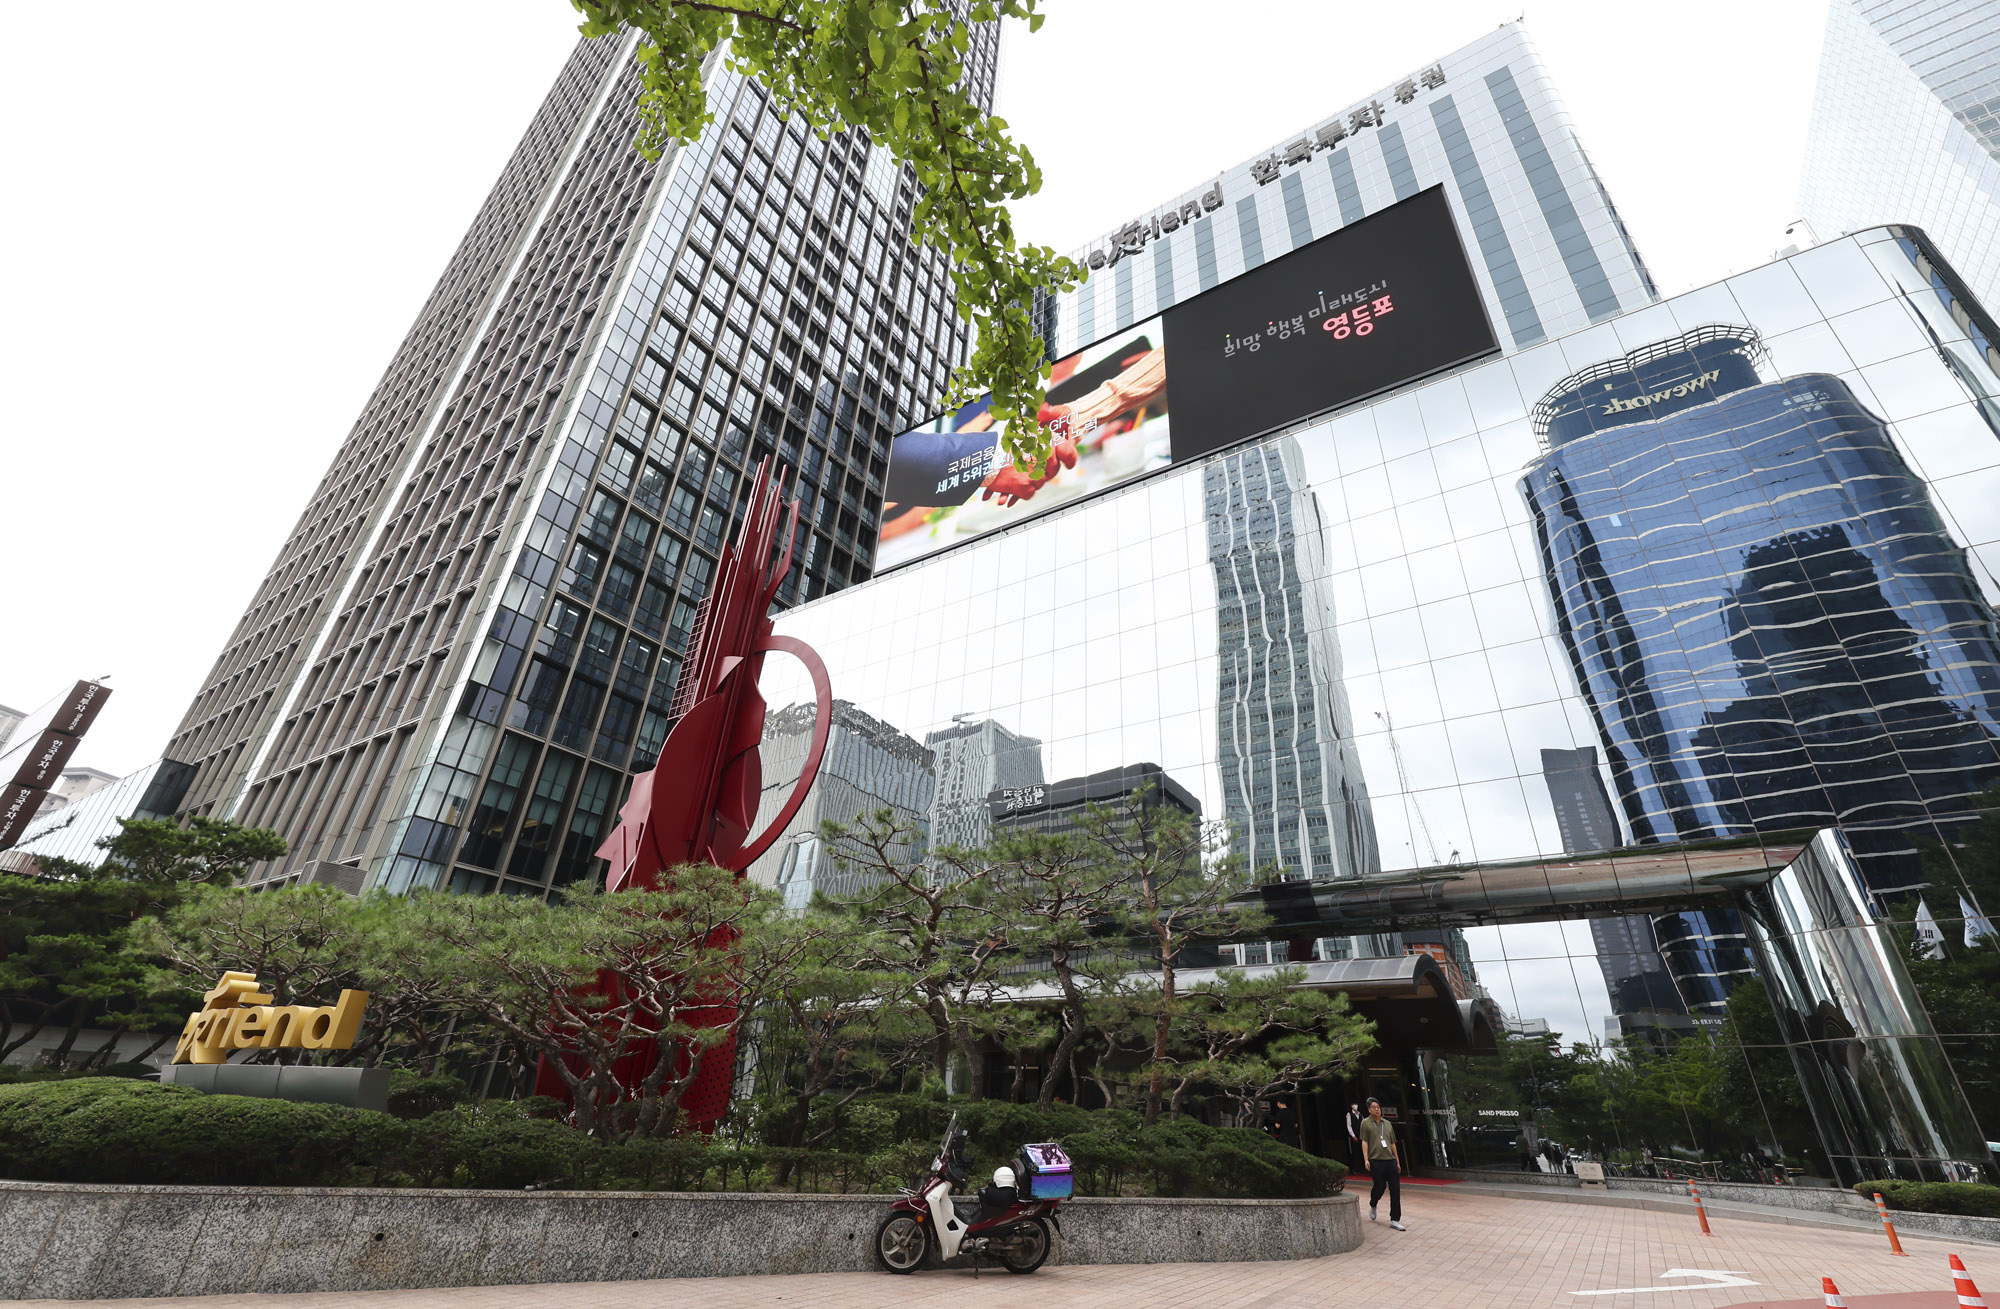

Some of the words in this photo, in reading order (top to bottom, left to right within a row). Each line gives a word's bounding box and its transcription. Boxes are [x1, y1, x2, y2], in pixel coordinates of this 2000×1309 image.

[1224, 333, 1261, 358] 희망
[1266, 315, 1306, 340] 행복
[1308, 279, 1387, 319] 미래도시
[1322, 295, 1394, 340] 영등포
[936, 473, 960, 494] 세계
[962, 460, 995, 483] 5위권
[75, 684, 99, 713] 한국투자
[38, 739, 63, 770] 한국투자
[4, 789, 31, 820] 한국투자
